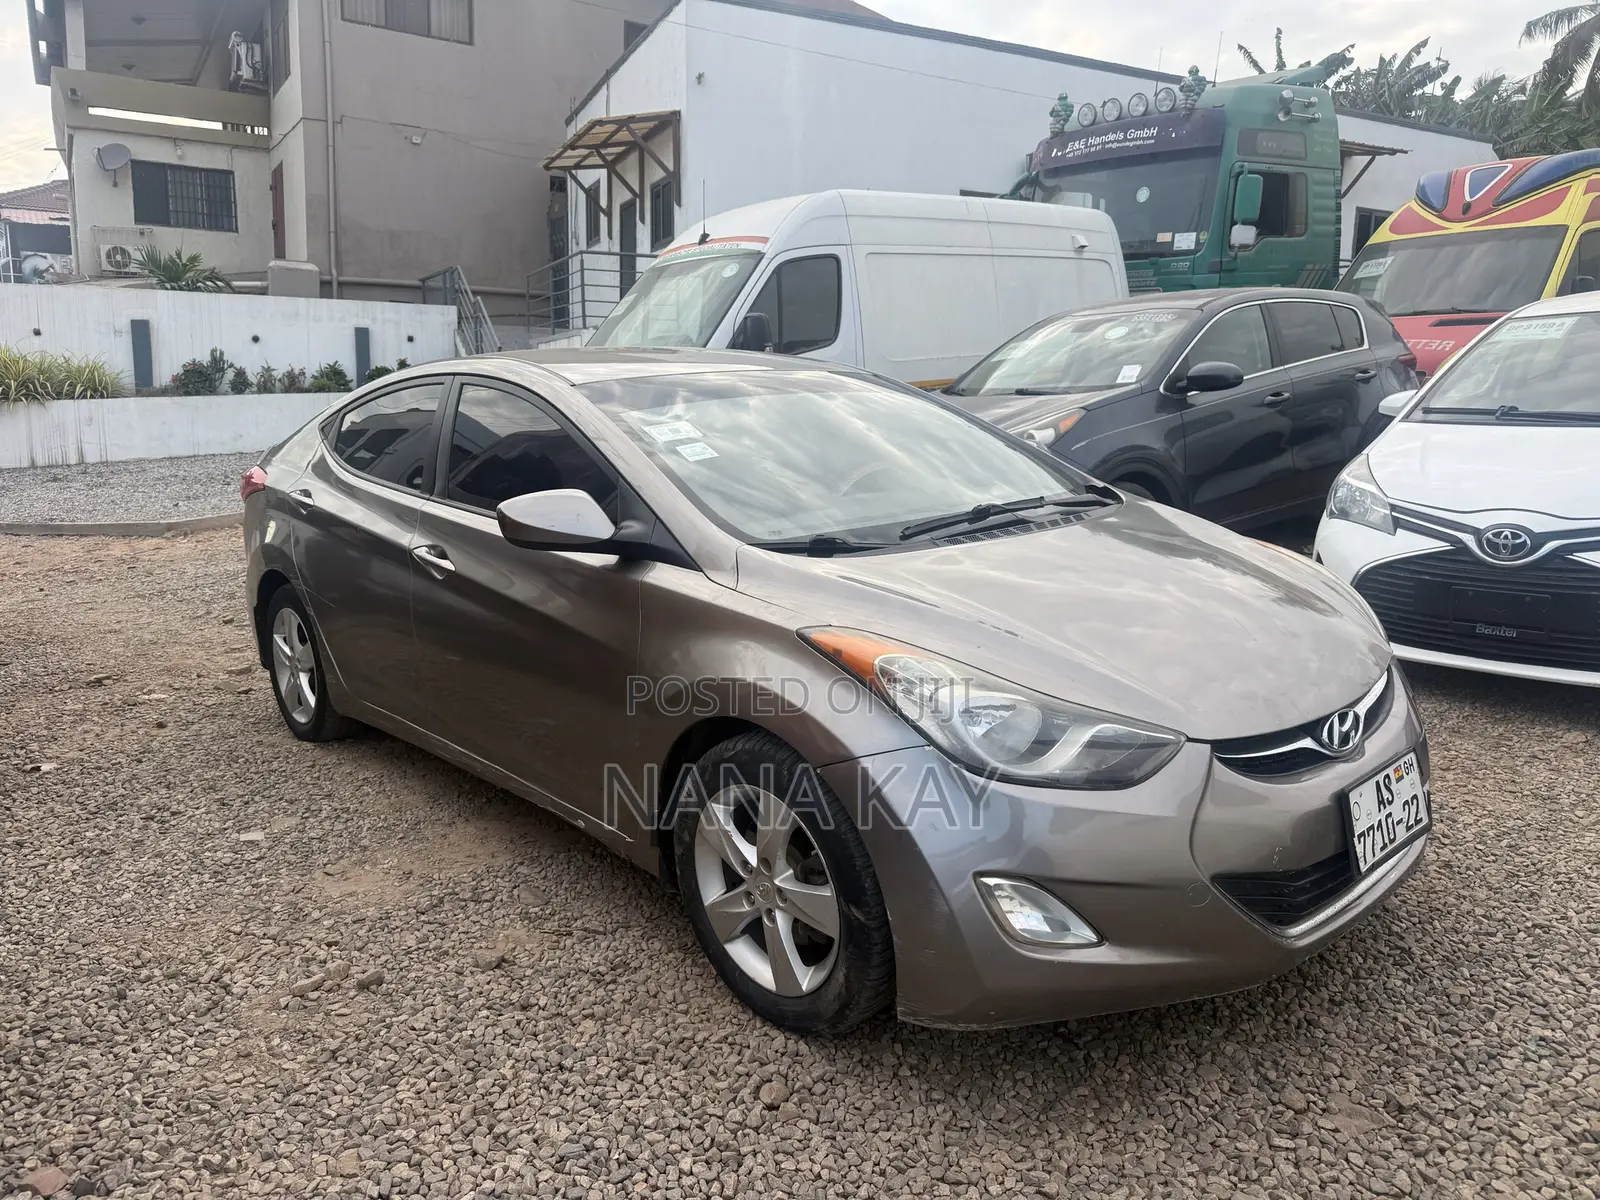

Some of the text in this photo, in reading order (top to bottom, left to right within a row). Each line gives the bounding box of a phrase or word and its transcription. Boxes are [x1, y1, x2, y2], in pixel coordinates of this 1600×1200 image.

[1066, 126, 1159, 153] E&E Handels GmbH
[1475, 623, 1517, 638] Baxter
[1375, 756, 1415, 813] AS GH
[1356, 793, 1423, 865] 7710-22
